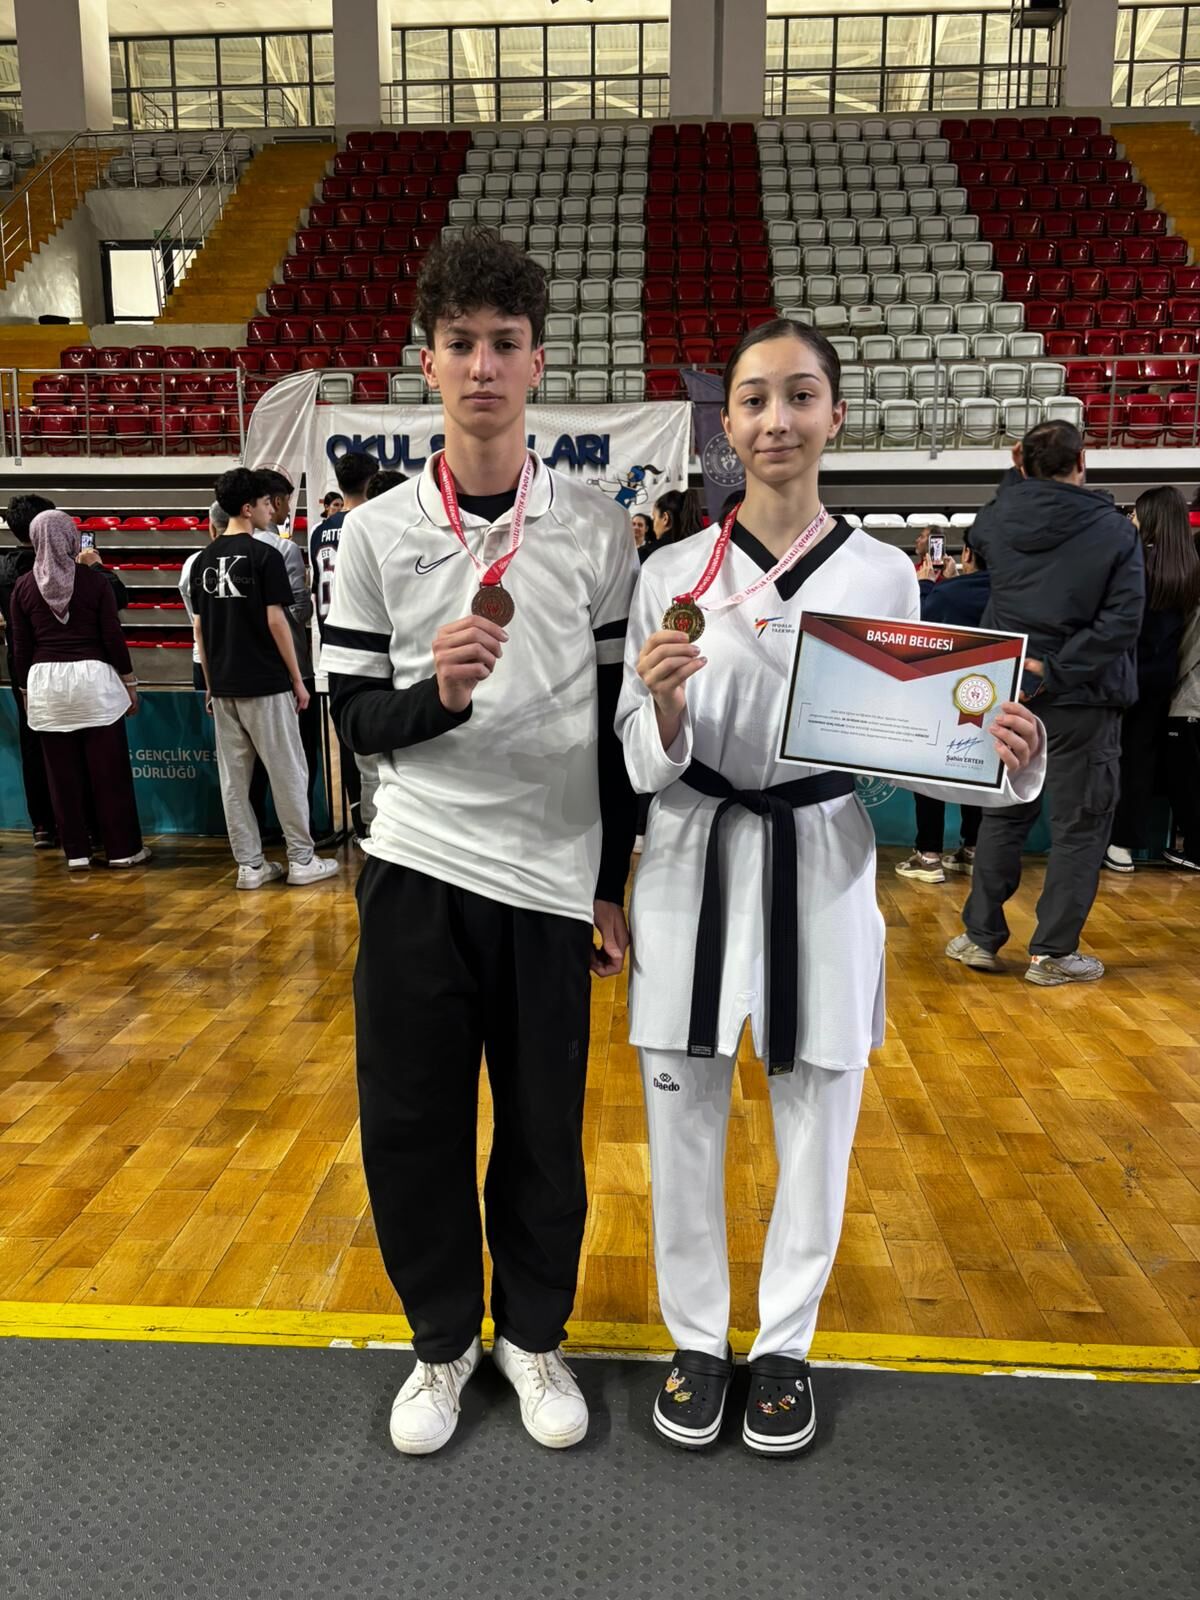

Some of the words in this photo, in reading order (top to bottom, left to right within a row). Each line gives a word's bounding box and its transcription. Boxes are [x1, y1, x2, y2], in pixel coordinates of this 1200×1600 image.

[326, 434, 426, 467] OKUL
[866, 629, 907, 645] BAŞARI
[909, 635, 954, 651] BELGESİ
[136, 748, 191, 764] GENÇLİK
[193, 750, 210, 761] VE
[132, 765, 197, 779] DÜRLÜĞÜ
[653, 1078, 680, 1092] Daedo
